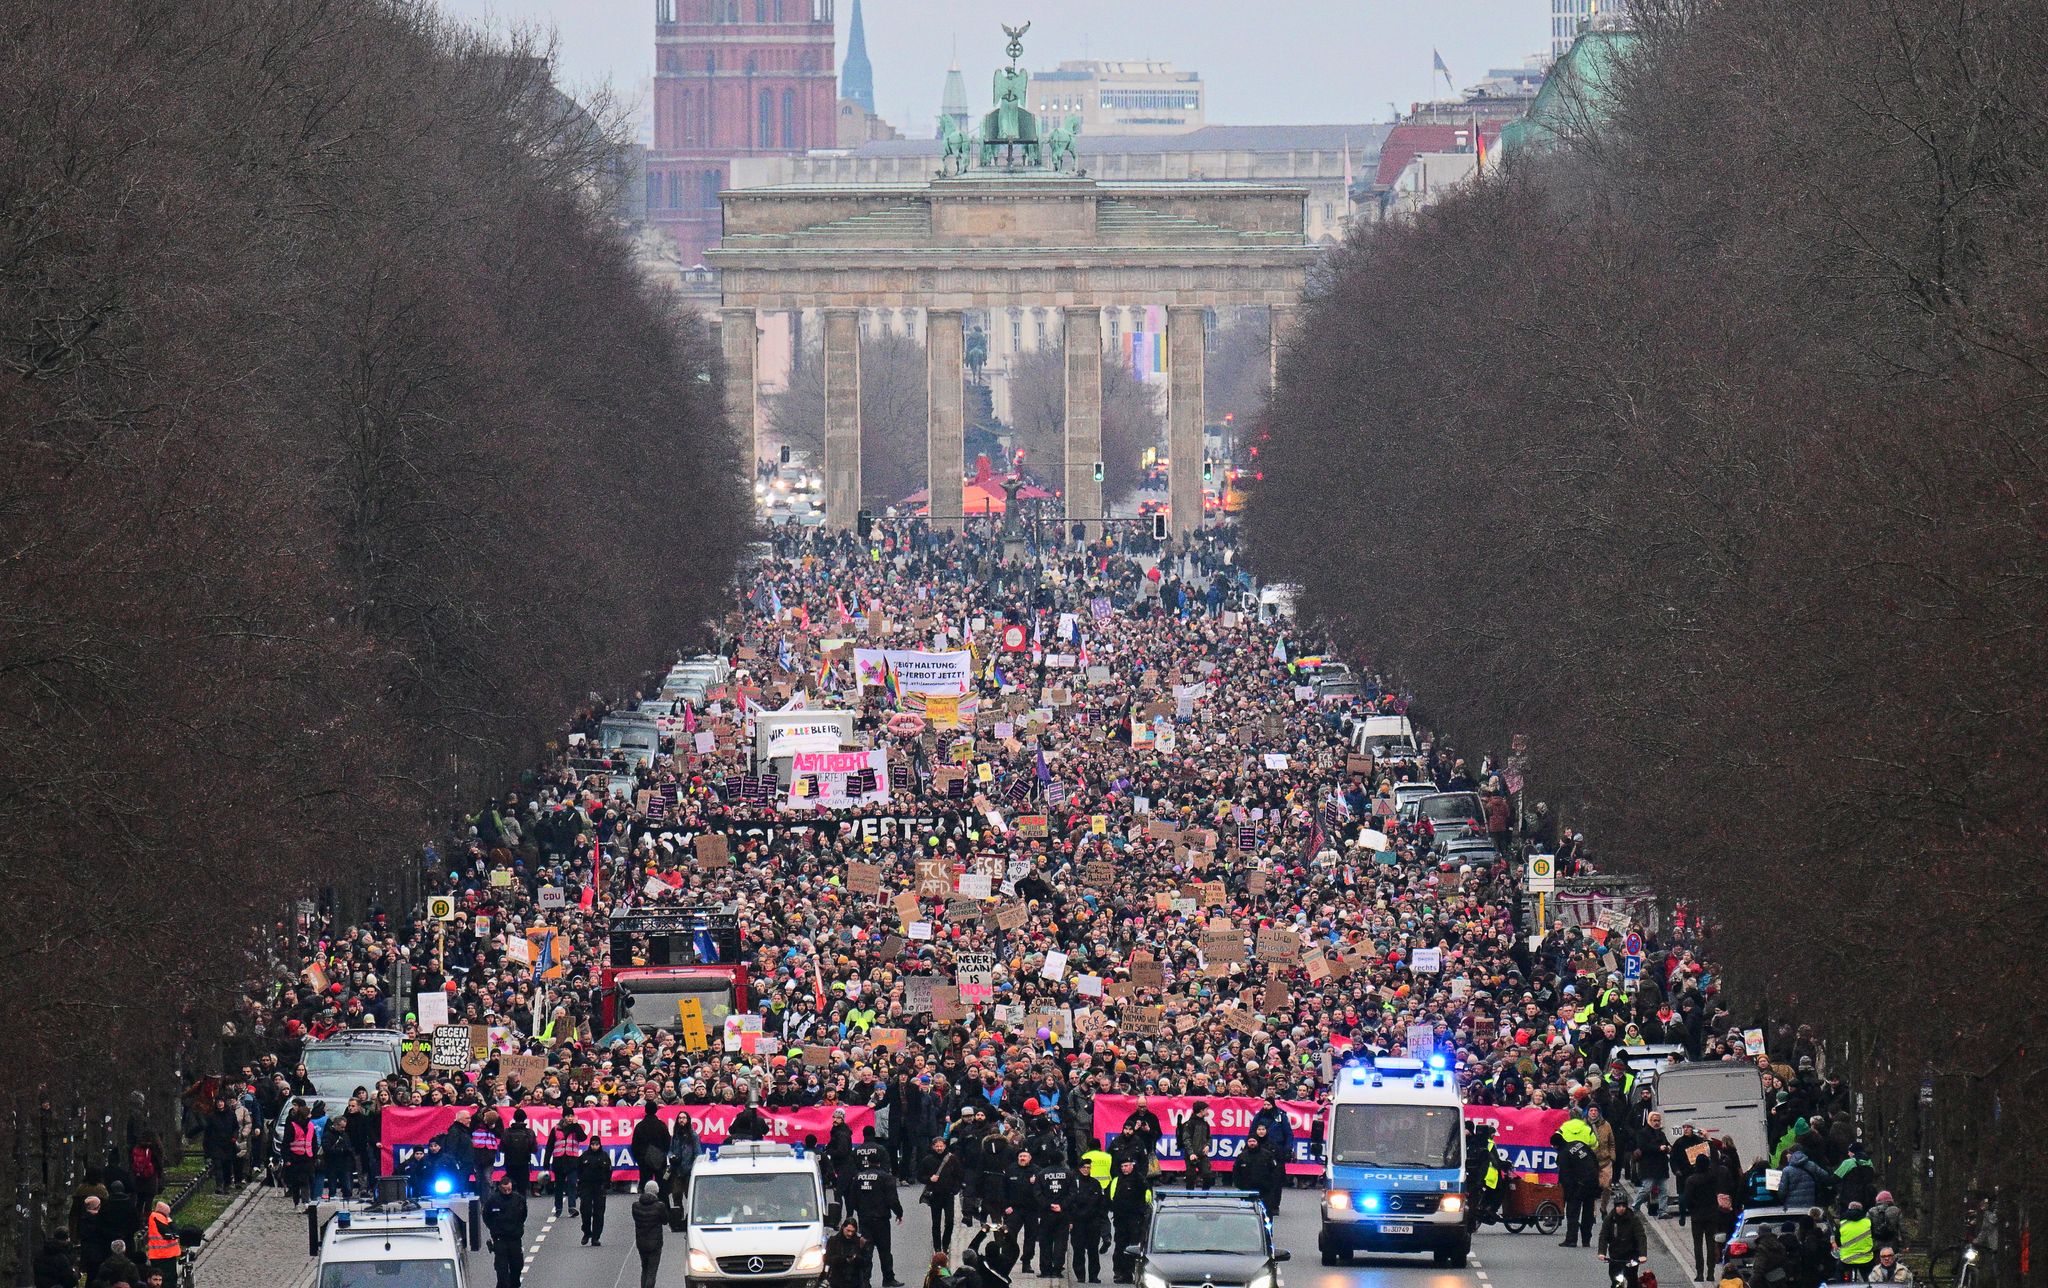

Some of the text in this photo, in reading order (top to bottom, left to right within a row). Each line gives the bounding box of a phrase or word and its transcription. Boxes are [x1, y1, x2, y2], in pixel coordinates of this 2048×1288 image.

[937, 671, 965, 679] JETZT!
[769, 728, 784, 742] WIR
[786, 727, 810, 736] ALLE
[793, 752, 870, 772] ASYLRECHT
[976, 857, 1003, 870] FCK
[918, 861, 949, 880] FCK
[920, 880, 951, 895] AFD
[543, 893, 561, 901] CDU
[437, 904, 445, 914] H
[959, 955, 989, 964] NEVER
[960, 964, 990, 973] AGAIN
[1627, 958, 1636, 976] P
[969, 974, 980, 984] IS
[960, 984, 992, 996] NOW
[1082, 1016, 1100, 1026] FCK
[436, 1027, 468, 1038] GEGEN
[435, 1038, 470, 1050] RECHTS!
[1409, 1036, 1432, 1046] IDEEN
[402, 1042, 413, 1052] NO
[1168, 1108, 1216, 1127] WR
[1220, 1108, 1258, 1128] SIN
[1672, 1127, 1683, 1136] 100
[1514, 1150, 1558, 1169] AFD
[857, 1173, 878, 1181] POLIZEI
[1044, 1172, 1066, 1180] POLIZEI
[1363, 1173, 1429, 1182] POLIZEI
